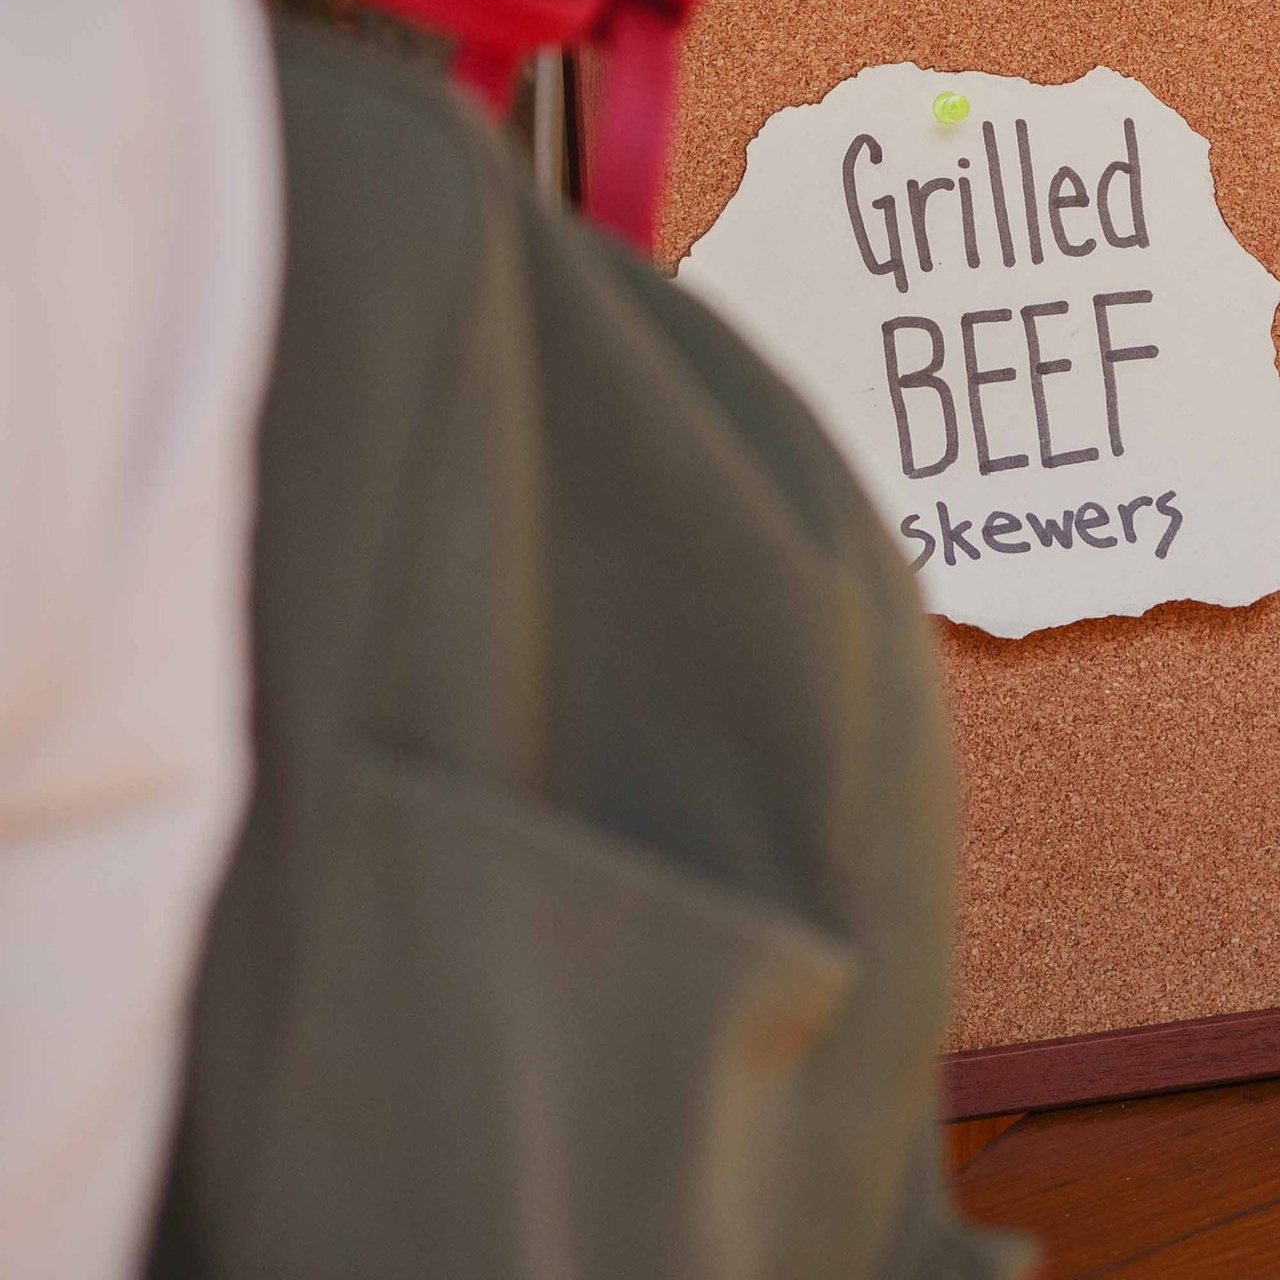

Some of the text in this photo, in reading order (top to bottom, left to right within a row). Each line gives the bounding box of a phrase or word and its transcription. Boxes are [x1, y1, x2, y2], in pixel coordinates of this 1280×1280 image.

[842, 119, 1150, 292] Grilled
[881, 289, 1160, 479] BEEF
[900, 490, 1183, 573] skewers
